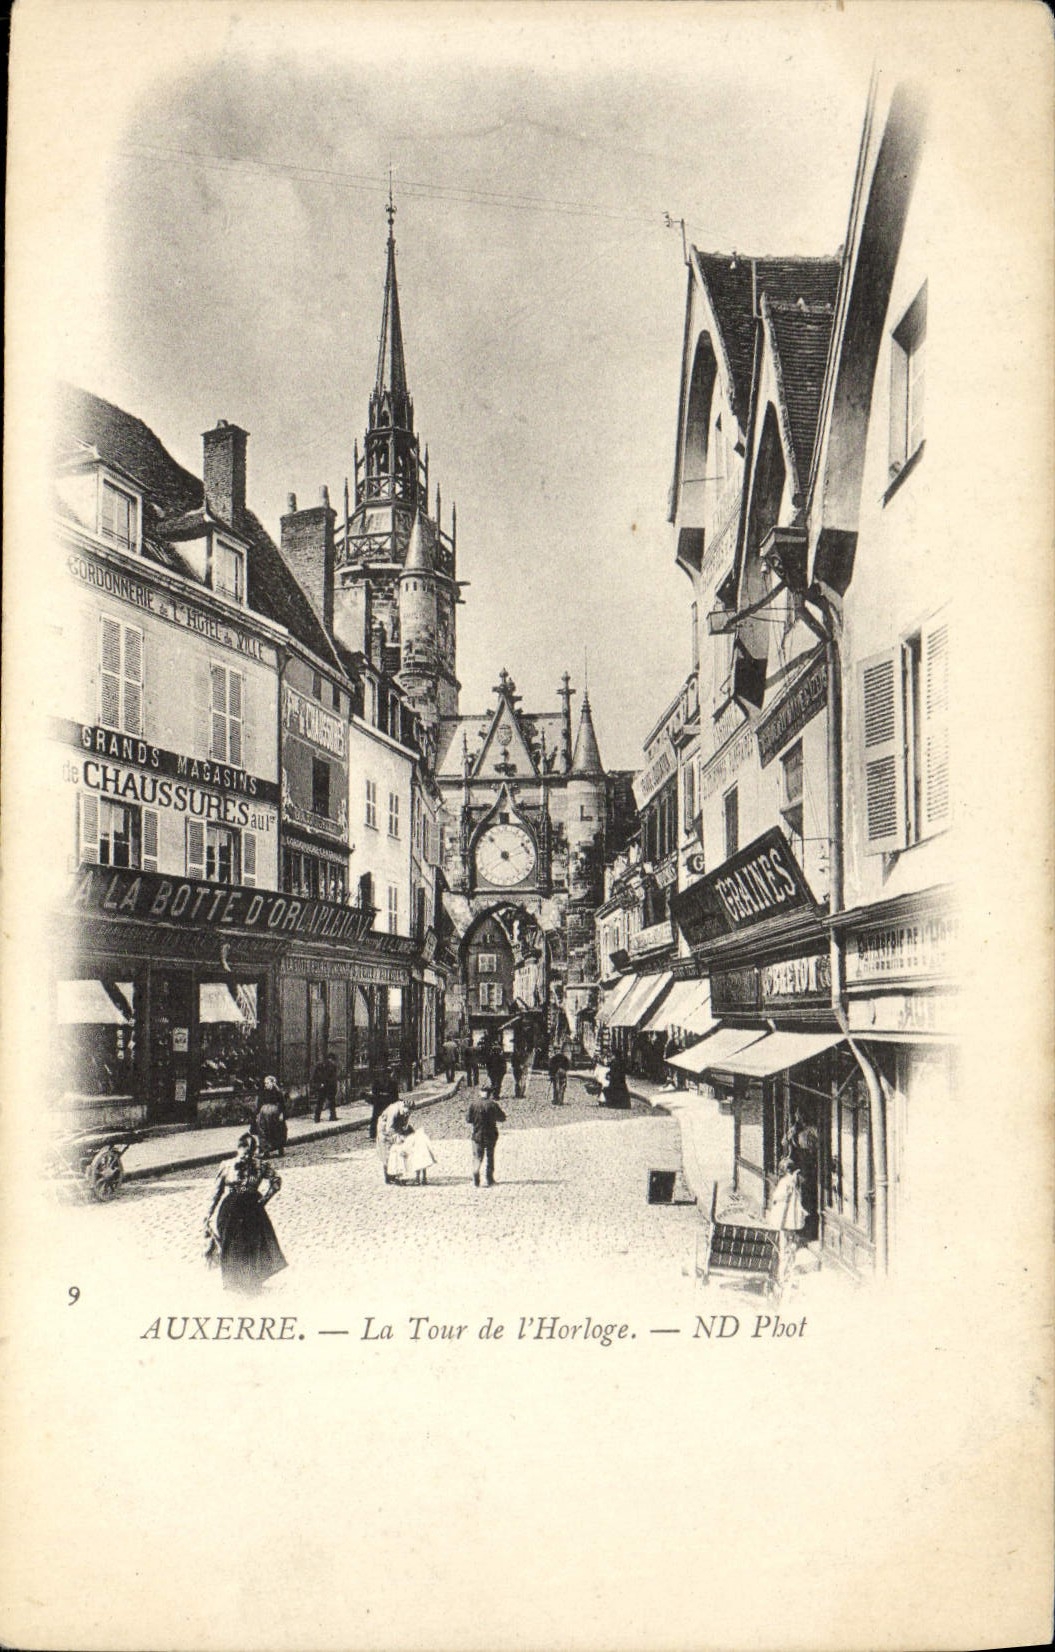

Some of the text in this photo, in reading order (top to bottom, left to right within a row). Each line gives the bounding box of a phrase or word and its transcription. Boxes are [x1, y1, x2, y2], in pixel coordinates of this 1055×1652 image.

[235, 624, 265, 661] VILLE
[80, 726, 258, 795] GRANDS MAGASINS
[83, 760, 250, 827] CHAUSSURES
[103, 873, 142, 911] LA
[151, 880, 243, 923] BOTTE
[244, 894, 303, 931] D'OR
[715, 847, 796, 922] GRAINES
